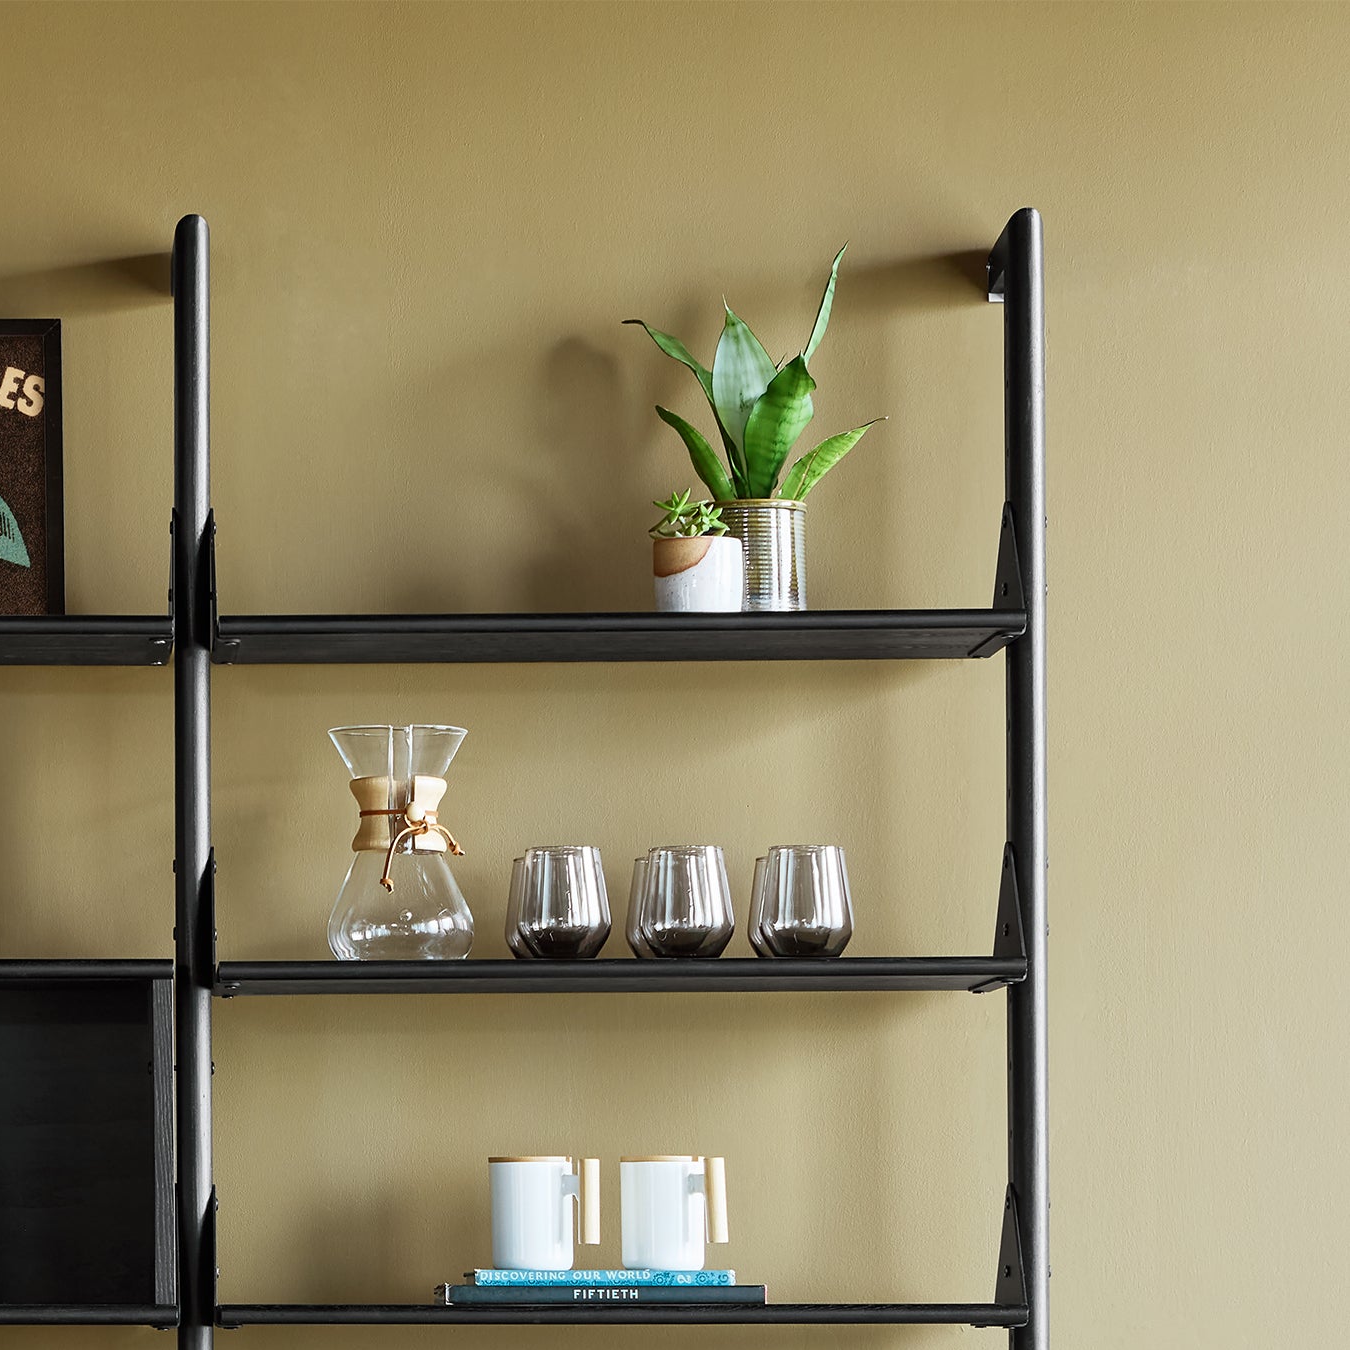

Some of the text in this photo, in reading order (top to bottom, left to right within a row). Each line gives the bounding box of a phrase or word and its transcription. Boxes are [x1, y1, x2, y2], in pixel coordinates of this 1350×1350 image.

[480, 1269, 651, 1281] DISCOVERING OUR WORLD
[573, 1289, 639, 1299] FIFTIETH
